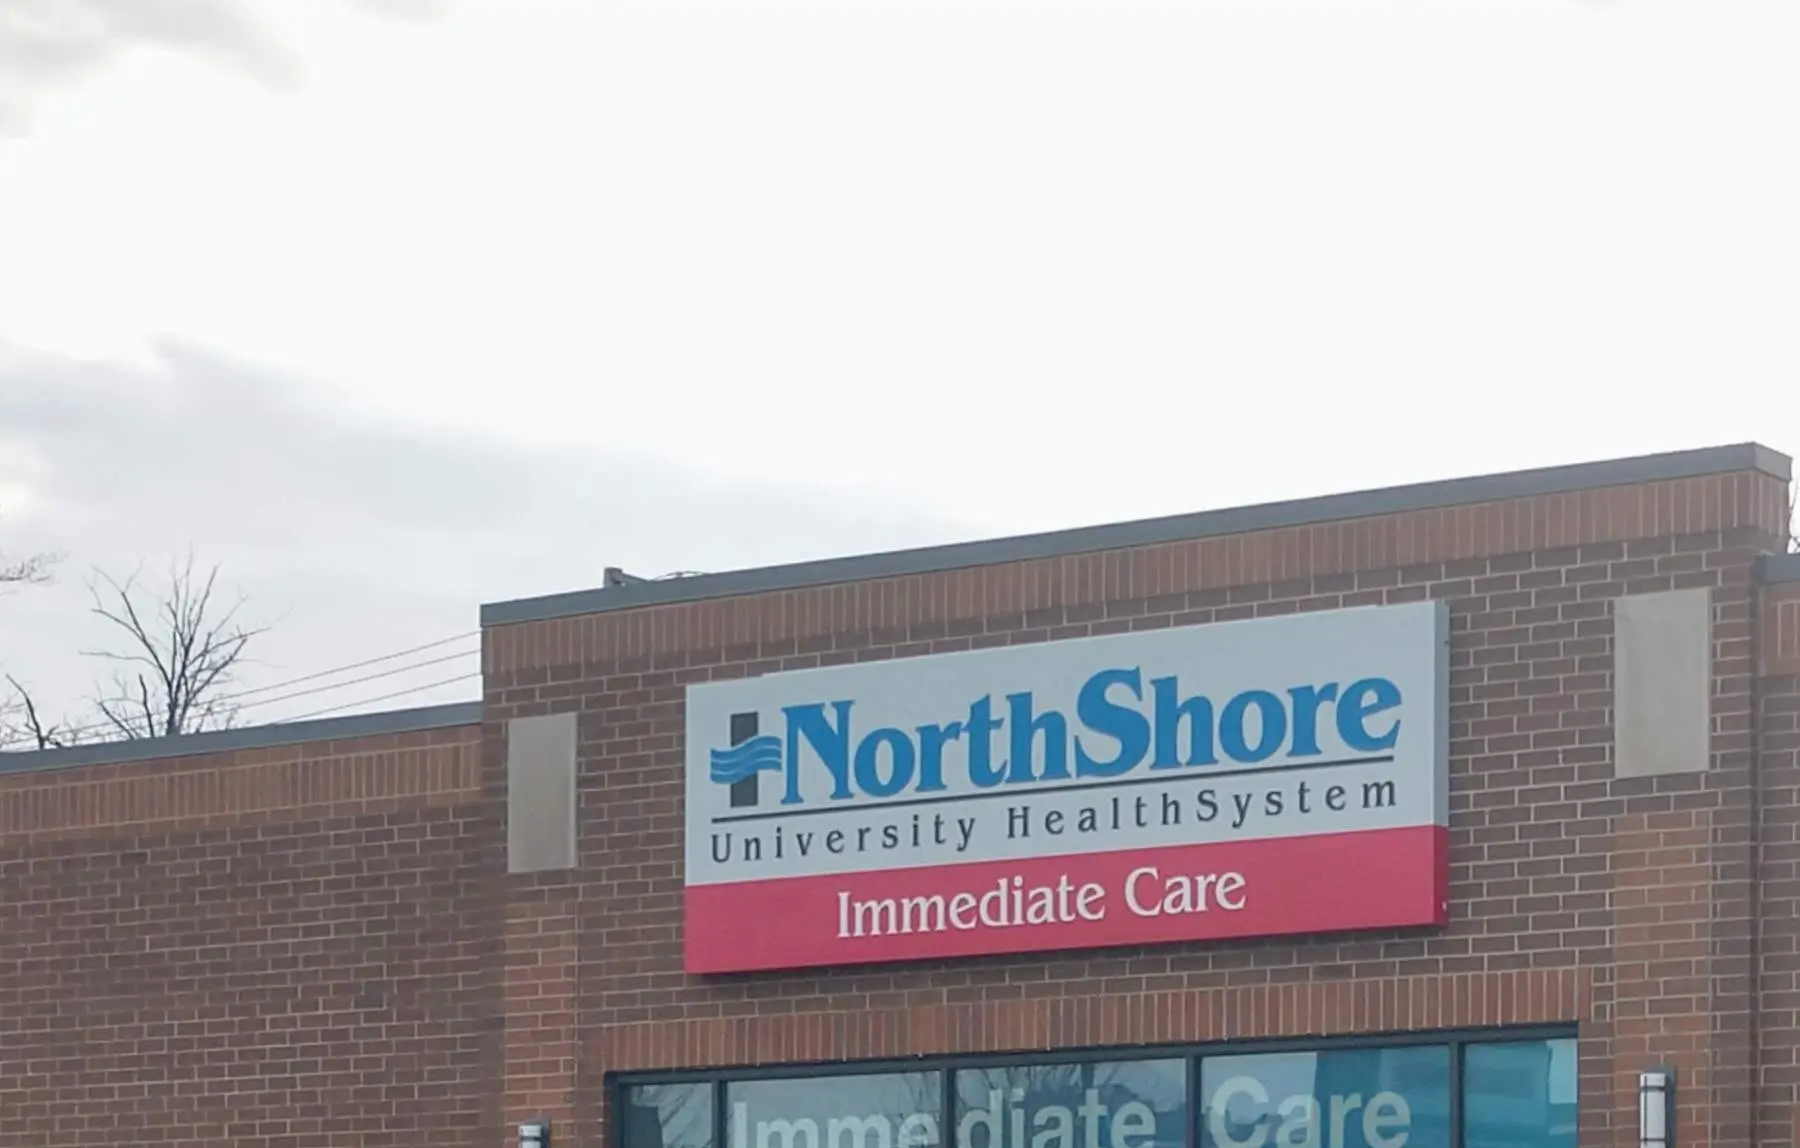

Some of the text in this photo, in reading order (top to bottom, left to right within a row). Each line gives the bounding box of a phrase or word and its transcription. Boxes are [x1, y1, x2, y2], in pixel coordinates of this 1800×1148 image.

[781, 666, 1403, 806] NorthShore
[709, 779, 1397, 864] University HealthSystem
[837, 866, 1248, 939] Immediate Care
